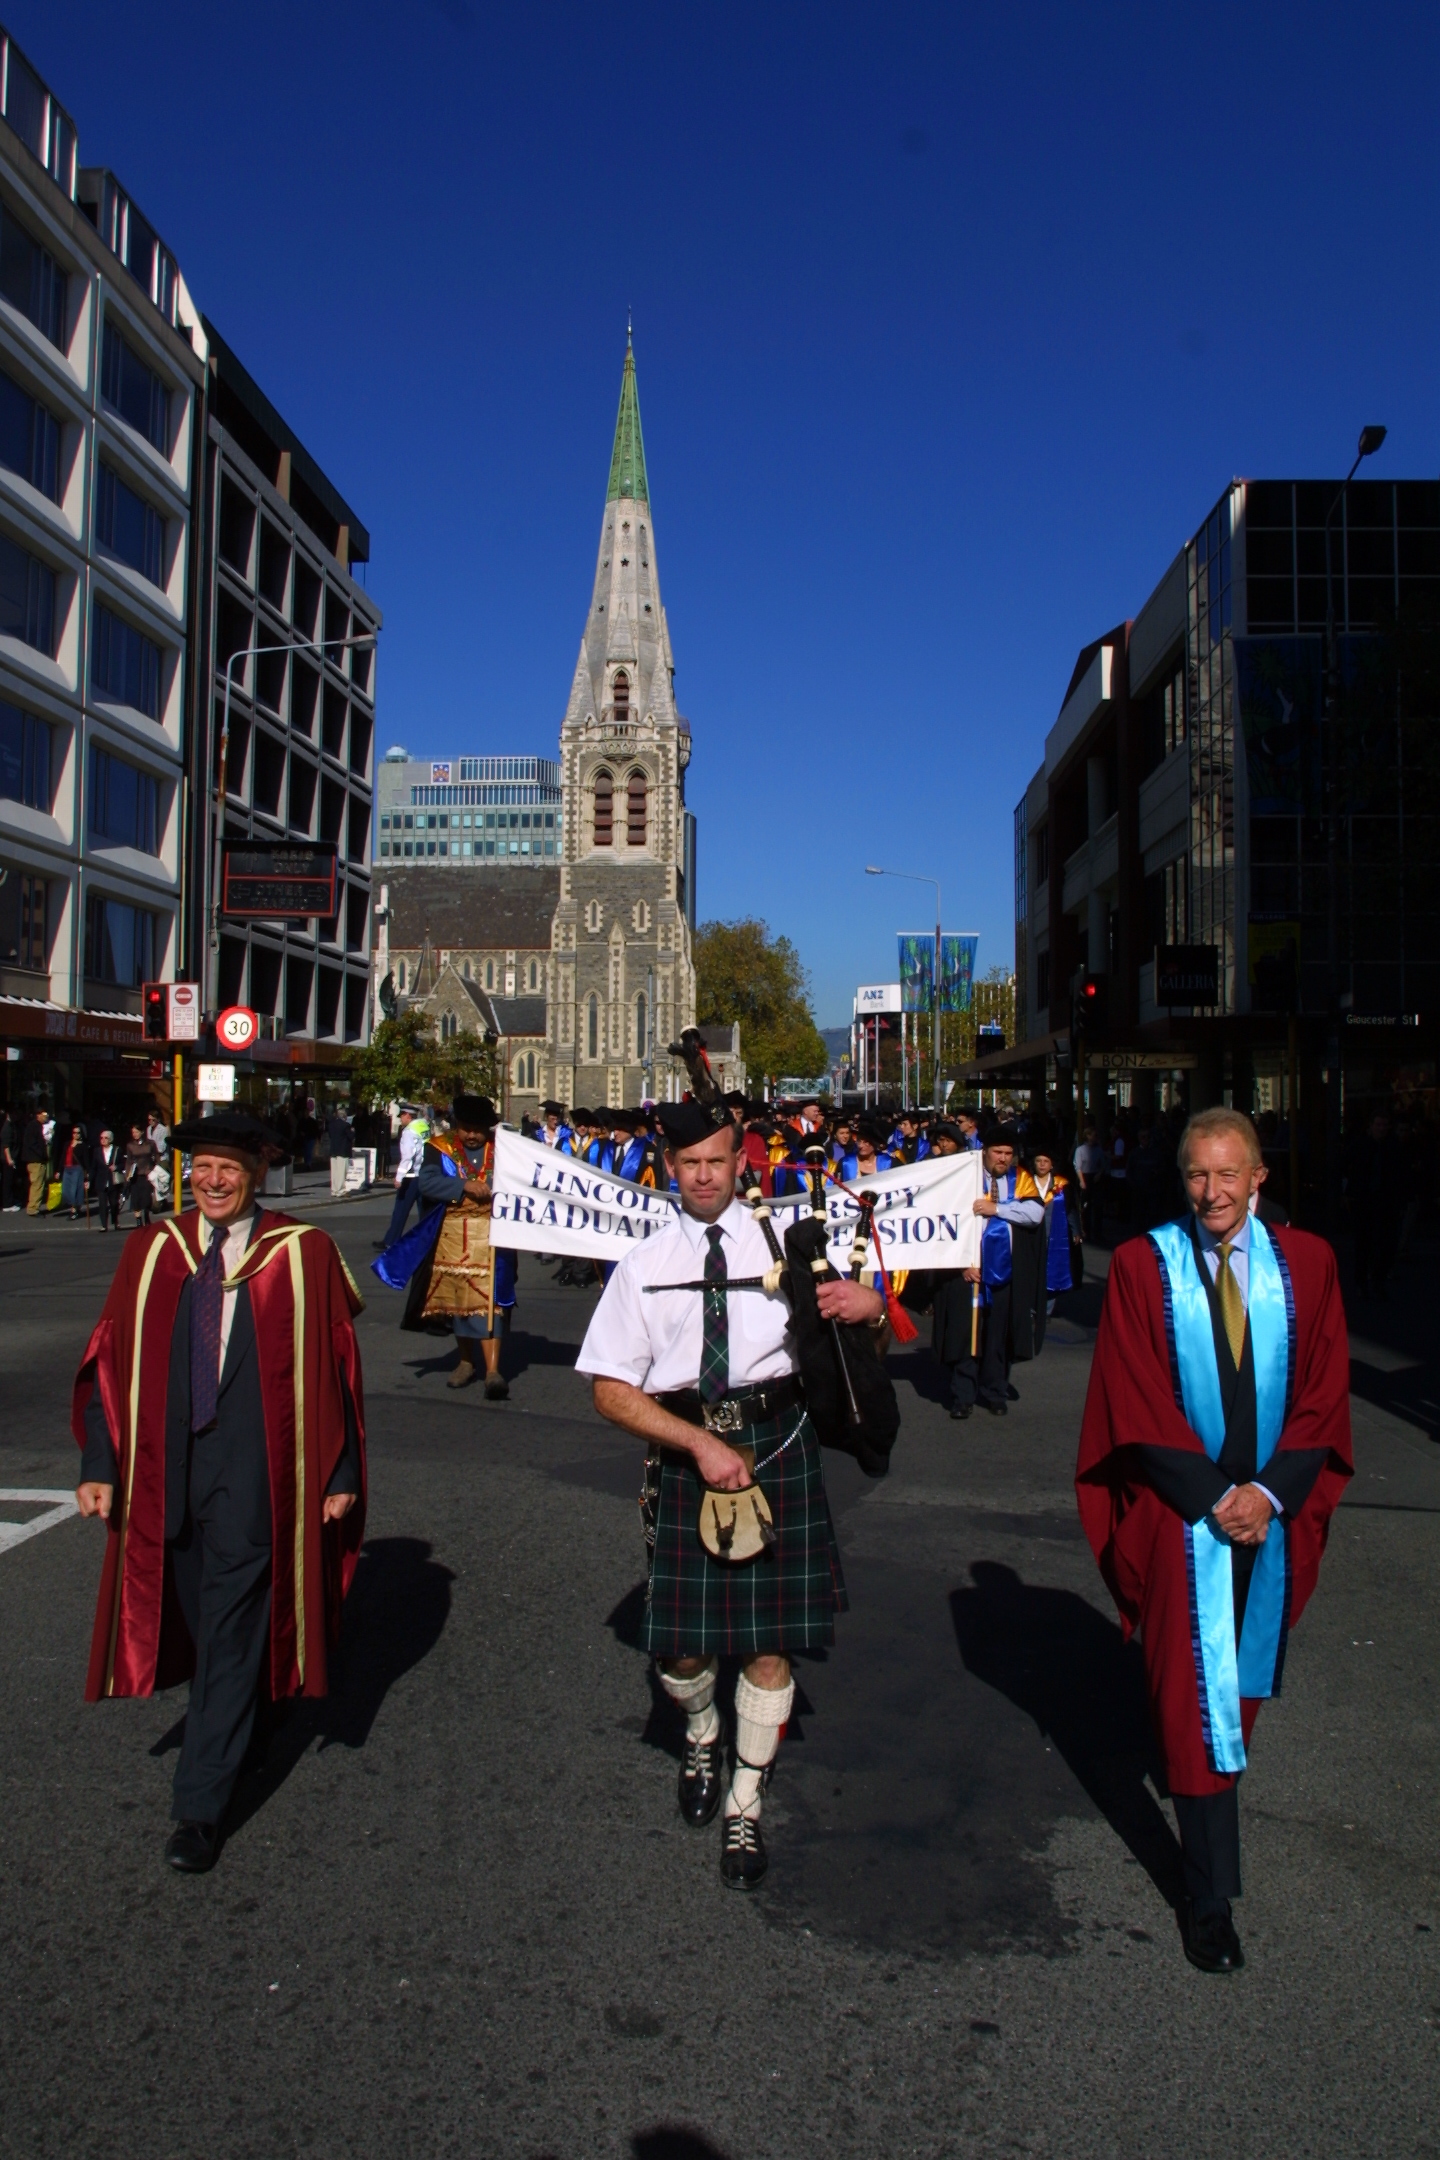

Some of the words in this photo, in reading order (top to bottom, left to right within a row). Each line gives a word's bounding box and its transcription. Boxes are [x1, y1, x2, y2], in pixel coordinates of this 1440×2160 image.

[1159, 974, 1216, 990] GALLERIA
[863, 989, 884, 1001] ANZ
[1346, 1014, 1397, 1025] Gloucester
[1402, 1014, 1413, 1025] St
[80, 1026, 101, 1041] CAFE
[103, 1029, 110, 1042] &
[228, 1020, 250, 1036] 30
[1102, 1054, 1147, 1067] BONZ
[490, 1191, 671, 1240] GRADUAT
